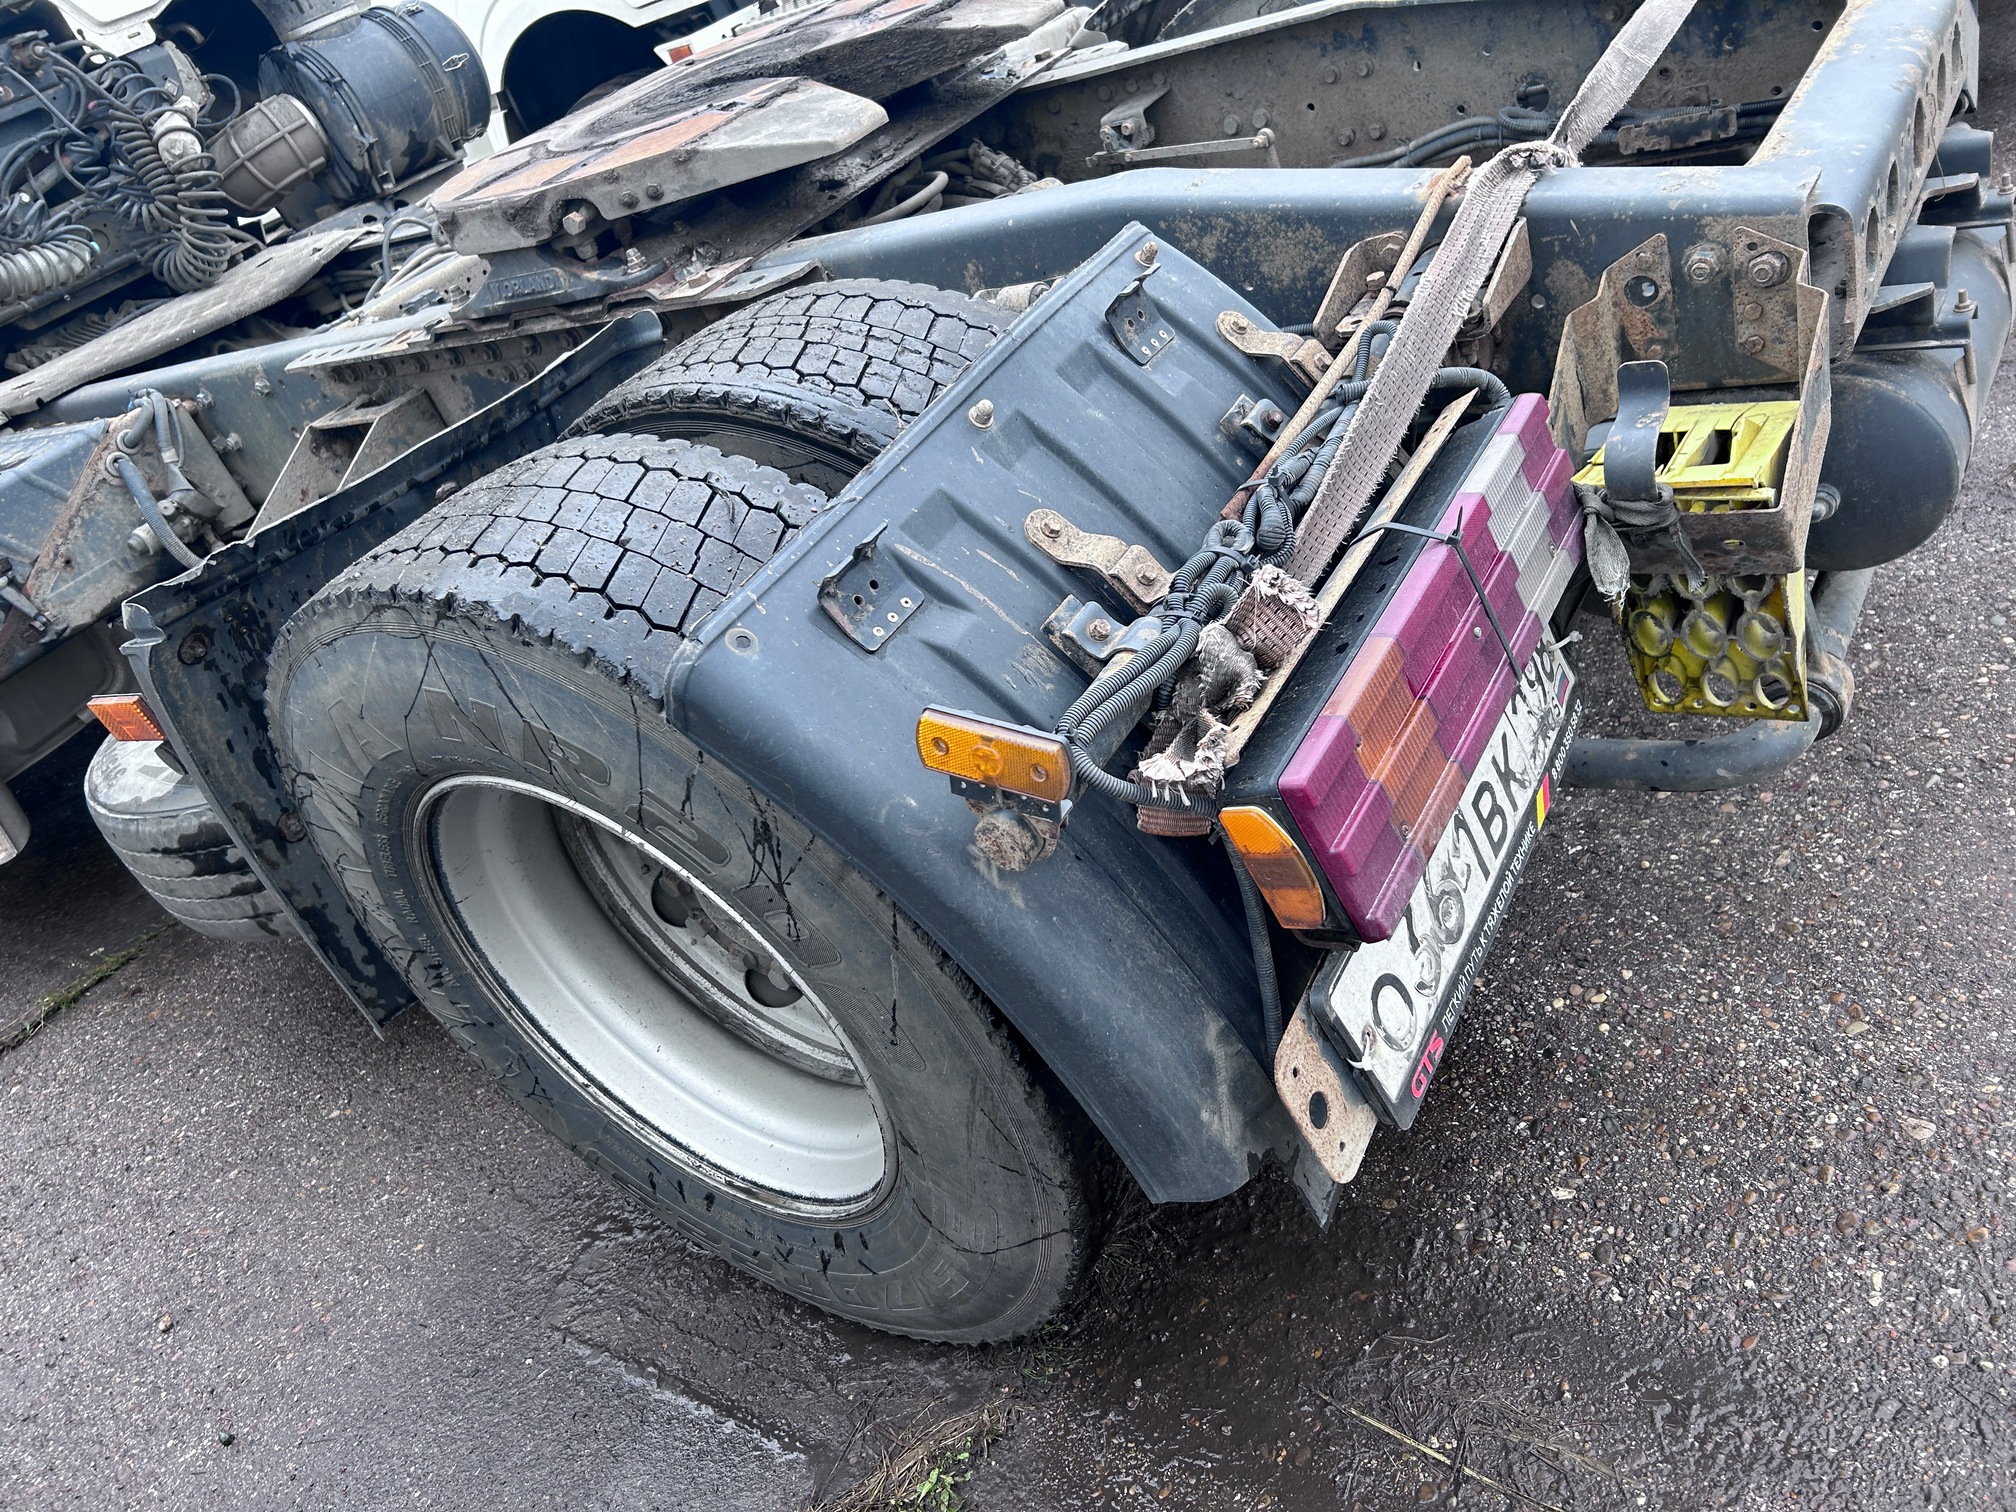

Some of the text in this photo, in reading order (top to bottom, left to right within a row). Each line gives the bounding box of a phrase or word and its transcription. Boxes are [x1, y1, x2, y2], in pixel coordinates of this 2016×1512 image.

[624, 788, 927, 1073] 202
[1441, 820, 1537, 1033] ЛЕГКИЙ ПУТЬ К ТЯЖЕЛОЙ ТЕХНИКЕ
[1411, 1029, 1444, 1099] GTS
